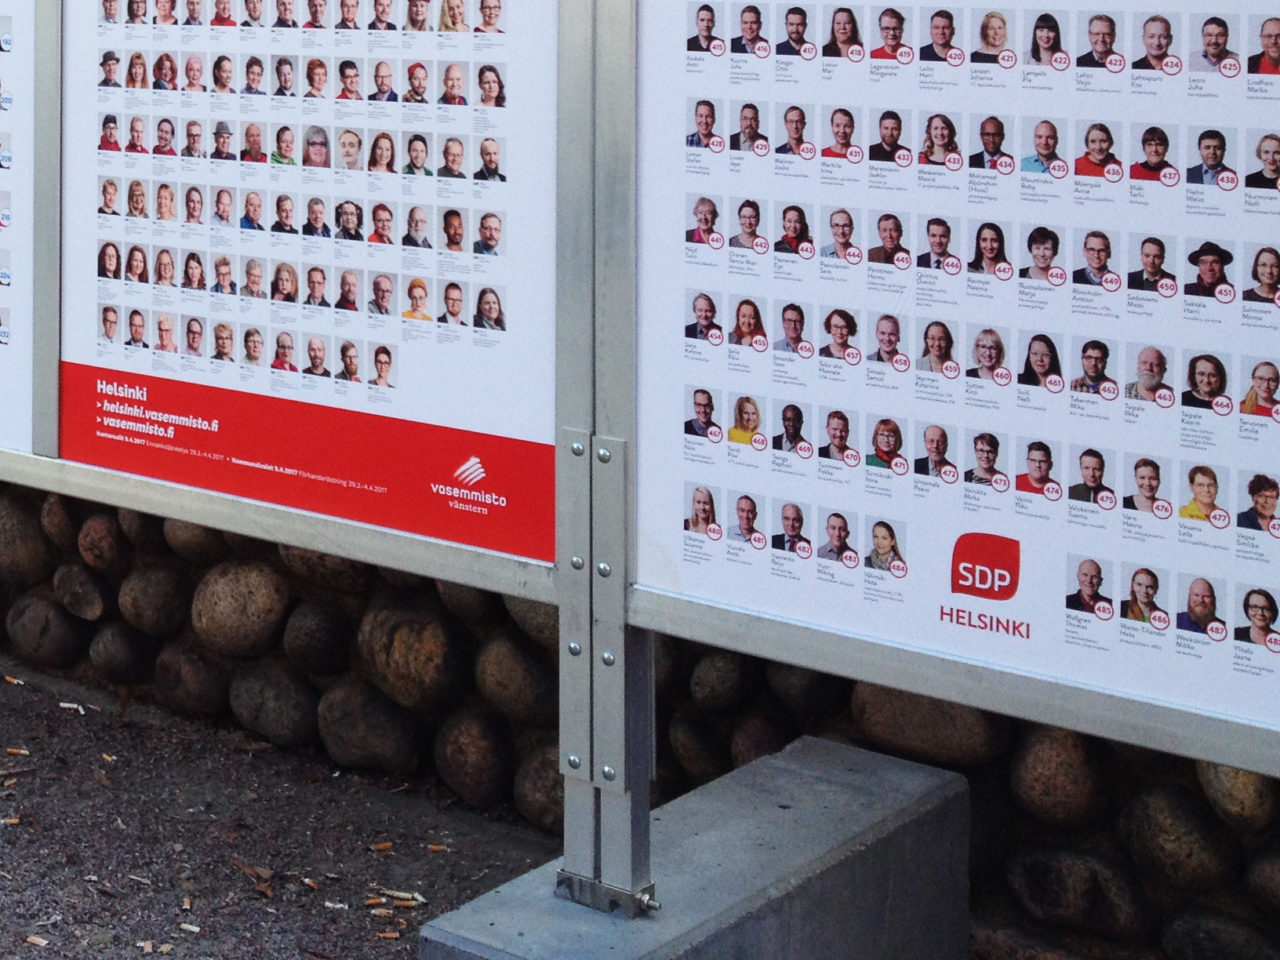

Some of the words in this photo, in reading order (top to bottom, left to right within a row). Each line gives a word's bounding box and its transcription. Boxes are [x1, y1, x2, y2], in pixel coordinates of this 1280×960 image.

[1222, 63, 1238, 71] 425
[754, 144, 768, 152] 429
[997, 161, 1012, 169] 434
[1105, 168, 1121, 176] 436
[1162, 170, 1178, 179] 437
[1219, 176, 1235, 184] 438
[945, 261, 960, 269] 446
[996, 265, 1012, 273] 447
[1049, 270, 1065, 280] 448
[1103, 277, 1119, 285] 449
[1159, 282, 1176, 291] 450
[1217, 289, 1232, 297] 451
[799, 345, 813, 353] 456
[894, 358, 908, 366] 458
[944, 365, 958, 373] 459
[994, 371, 1010, 380] 460
[97, 379, 148, 402] Helsinki
[1101, 386, 1116, 394] 462
[1157, 391, 1173, 402] 463
[1214, 401, 1230, 409] 464
[103, 399, 219, 432] helsinki.vasemmisto.fi
[103, 417, 175, 439] vasemmisto.fi
[798, 444, 812, 452] 469
[845, 452, 859, 461] 470
[943, 470, 956, 478] 472
[993, 478, 1007, 486] 473
[431, 482, 507, 507] vasemmisto
[1045, 487, 1059, 495] 474
[1099, 496, 1114, 504] 475
[448, 499, 488, 515] vänstern
[1154, 505, 1169, 513] 476
[1211, 512, 1228, 522] 477
[797, 544, 811, 553] 482
[958, 561, 1011, 592] SDP
[1096, 606, 1111, 614] 485
[940, 605, 1032, 640] HELSINKI
[1152, 615, 1168, 624] 486
[1209, 624, 1225, 635] 487
